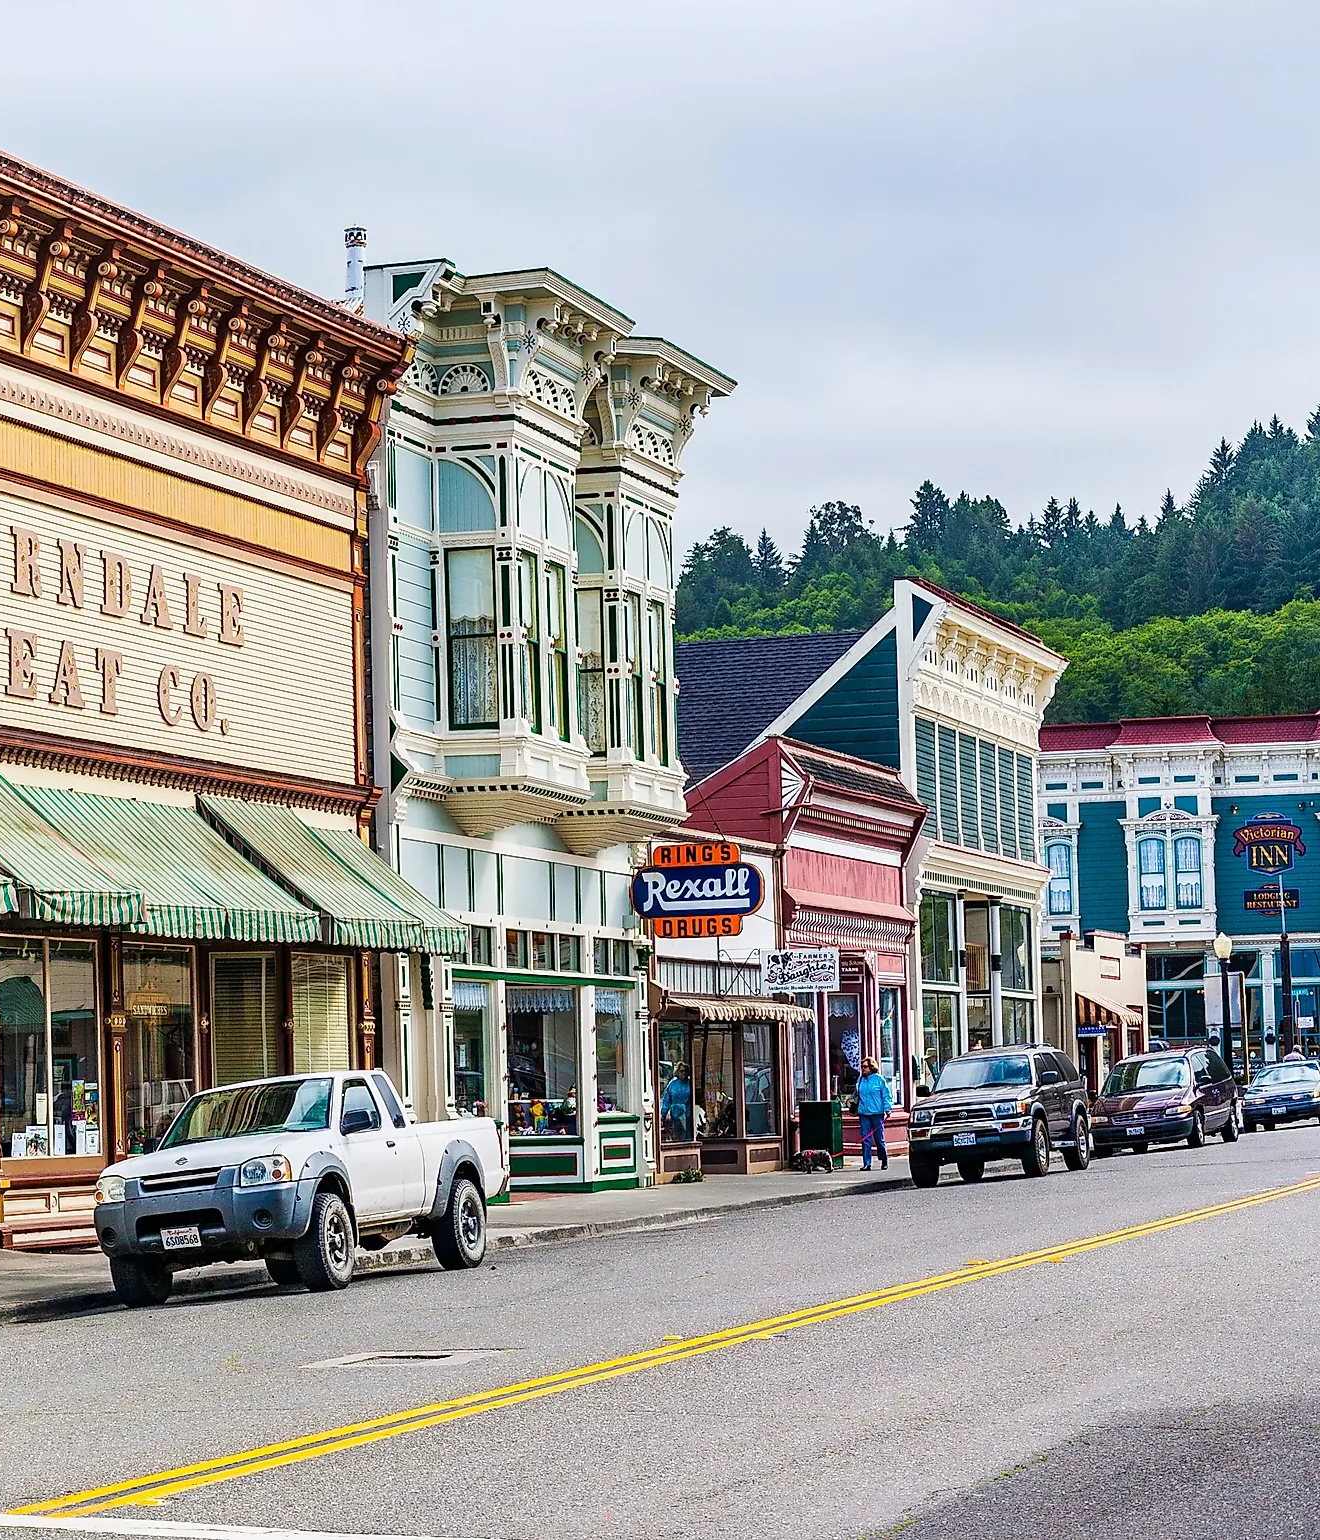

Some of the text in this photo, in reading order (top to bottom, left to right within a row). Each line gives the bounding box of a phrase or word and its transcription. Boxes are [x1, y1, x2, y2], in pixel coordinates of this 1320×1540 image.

[157, 664, 229, 736] CO.
[1239, 826, 1295, 842] Victorian
[661, 844, 731, 863] RING'S
[1251, 845, 1289, 866] INN
[641, 868, 750, 911] Rexall
[1253, 892, 1290, 900] LODGIG
[662, 918, 732, 936] DRUGS
[777, 963, 834, 983] Daughter
